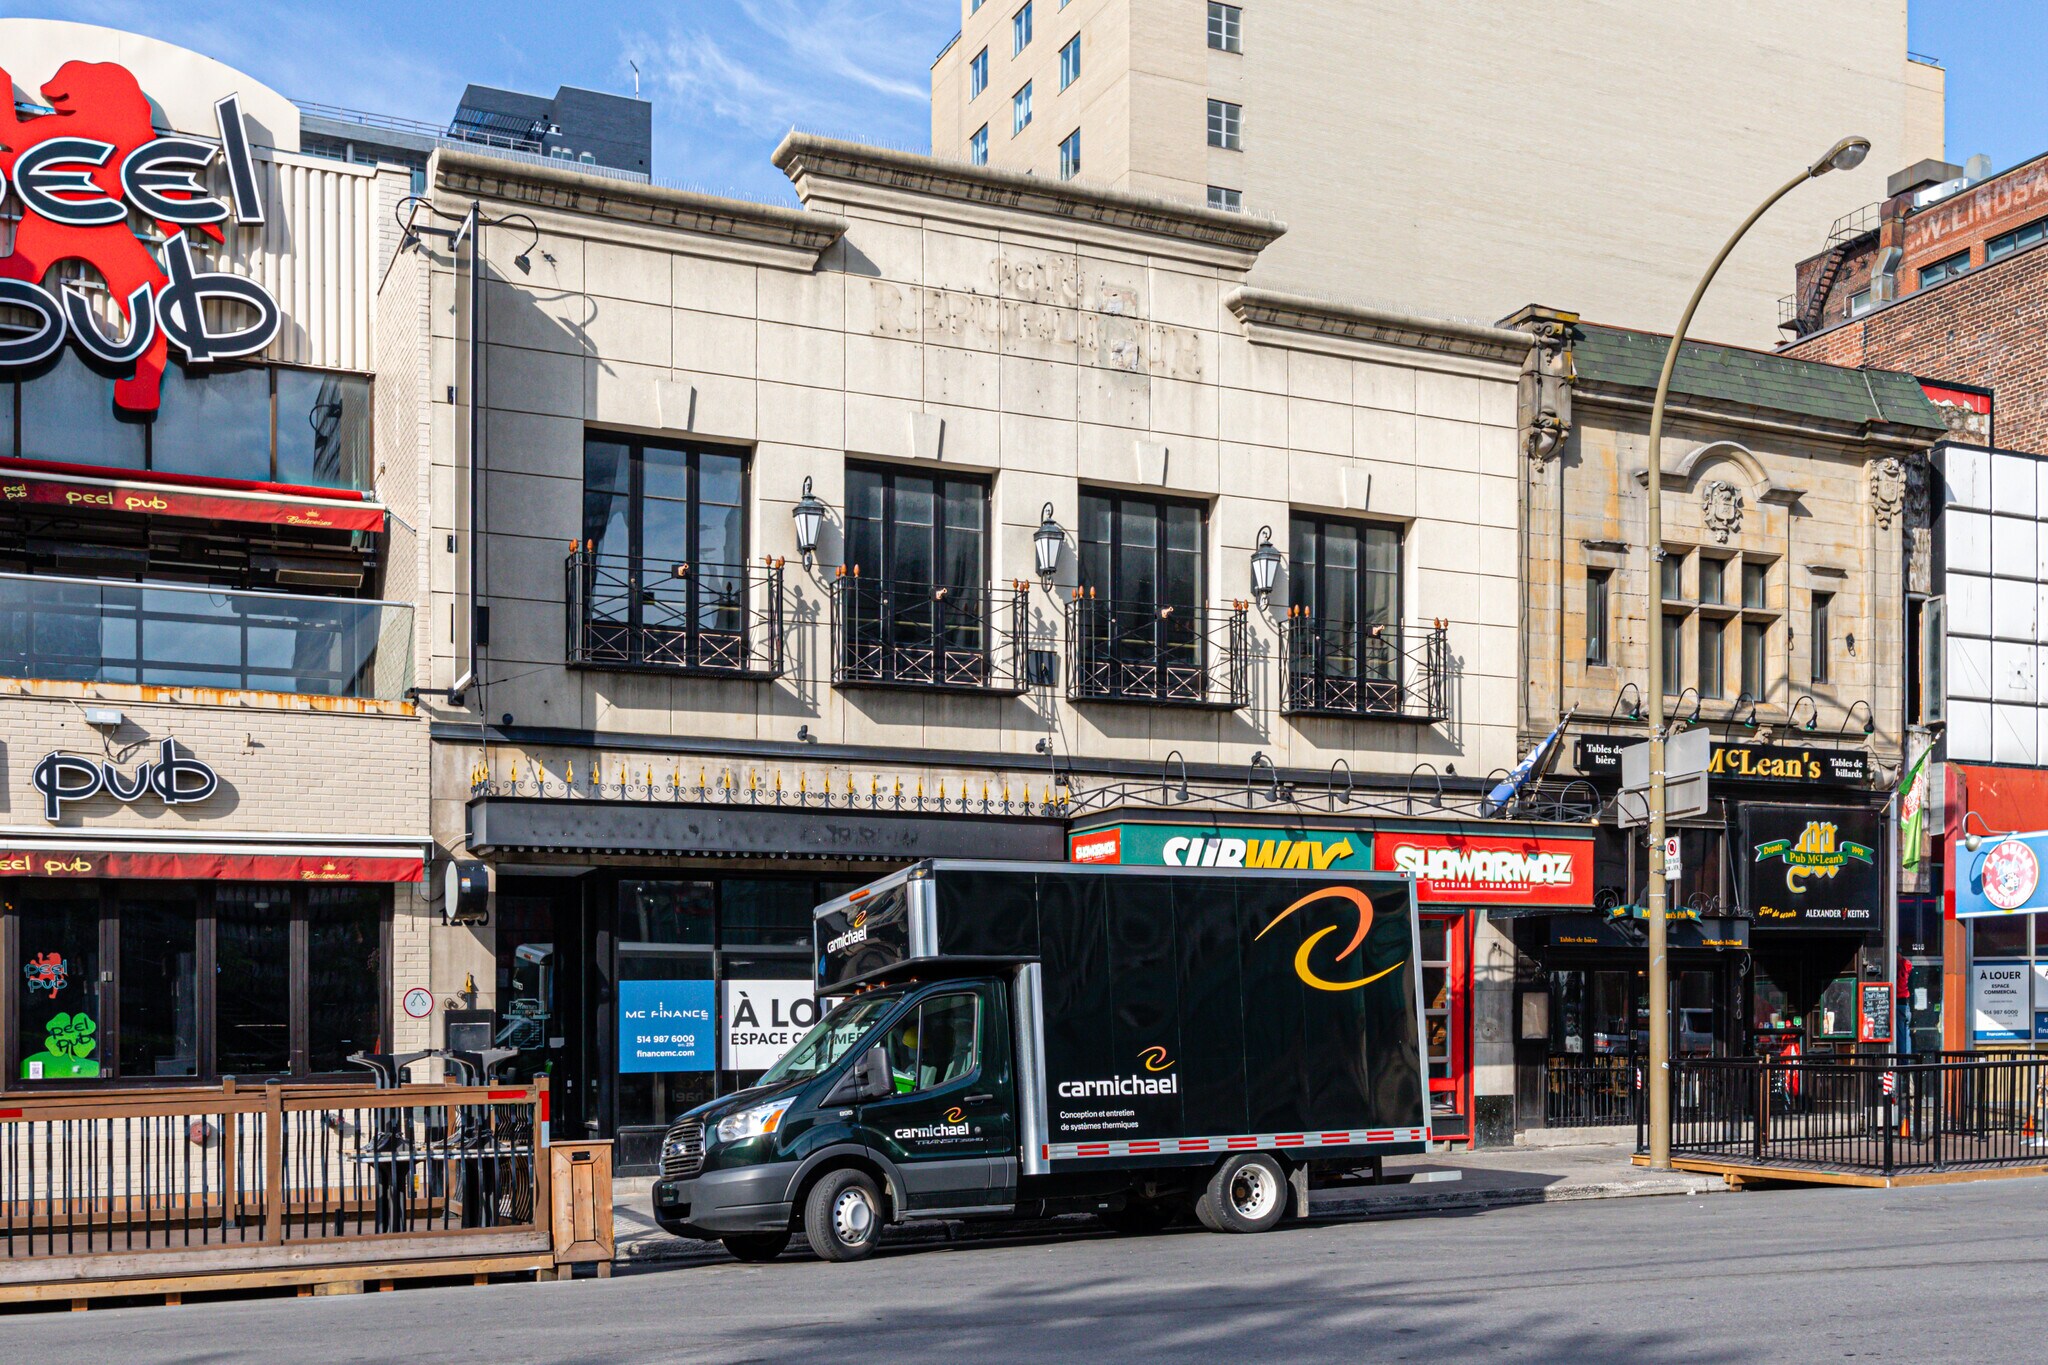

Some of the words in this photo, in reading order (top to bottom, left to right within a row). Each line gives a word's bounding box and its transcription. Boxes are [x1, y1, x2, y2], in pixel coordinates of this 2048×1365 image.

[0, 92, 265, 226] eel
[65, 491, 113, 505] peel
[125, 496, 168, 510] pub
[286, 515, 332, 527] Budweiser
[1586, 743, 1612, 754] Tables
[1595, 755, 1616, 765] bière
[1708, 748, 1822, 779] McLean's
[1830, 758, 1853, 769] Tables
[1854, 760, 1863, 769] de
[33, 737, 218, 821] pub
[1835, 768, 1863, 779] billards
[1763, 843, 1783, 856] Depuis
[1789, 851, 1806, 863] Pub
[1807, 853, 1843, 864] McLean's
[0, 855, 31, 871] eel
[44, 857, 91, 876] pub
[1394, 845, 1572, 885] SHAWARMAZ
[301, 870, 350, 880] Budweiser
[1805, 908, 1842, 918] ALEXANDER
[1847, 909, 1870, 918] KEITH'S
[827, 924, 867, 954] carmichael
[23, 959, 68, 979] peel
[1980, 969, 1988, 980] À
[1989, 971, 2021, 980] LOUER
[27, 974, 68, 993] pub
[625, 1010, 646, 1019] MC
[651, 1001, 709, 1018] FINANCE
[731, 991, 760, 1028] À
[636, 1035, 651, 1043] 514
[653, 1035, 669, 1043] 987
[671, 1034, 695, 1043] 6000
[731, 1032, 788, 1045] ESPACE
[636, 1049, 695, 1057] financemc.com
[1058, 1073, 1178, 1098] carmichael
[1060, 1111, 1098, 1119] Conception
[1098, 1110, 1105, 1118] et
[1105, 1109, 1135, 1117] entretien
[894, 1122, 969, 1139] carmichael
[1060, 1123, 1070, 1131] de
[1070, 1122, 1102, 1132] systèmes
[1102, 1120, 1139, 1130] thermiques
